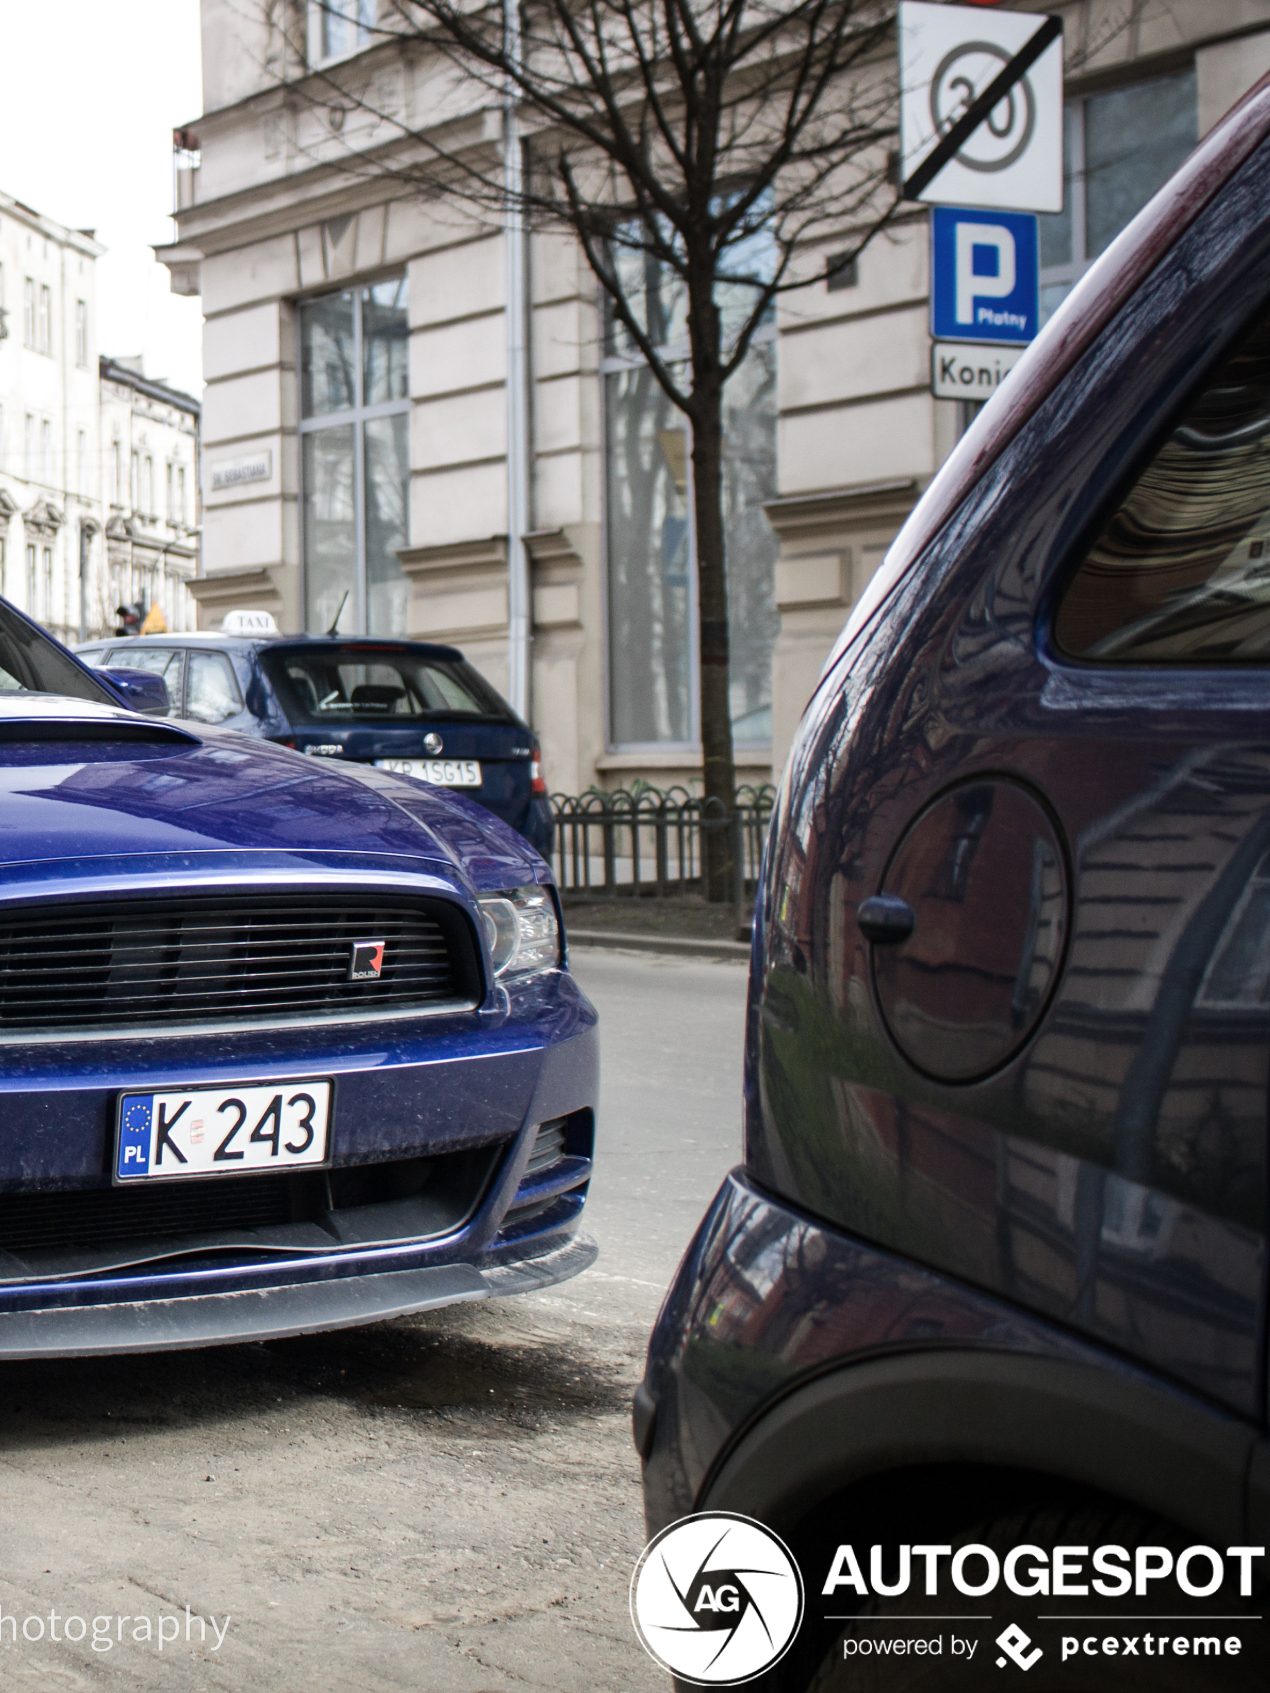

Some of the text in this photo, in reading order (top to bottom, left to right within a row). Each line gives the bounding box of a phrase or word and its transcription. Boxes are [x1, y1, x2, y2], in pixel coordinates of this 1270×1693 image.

[956, 223, 1016, 324] P
[977, 307, 1027, 330] Płatny
[941, 357, 1012, 386] Koni
[224, 462, 266, 483] SEBASTIANA
[238, 615, 270, 628] TAXI
[422, 761, 476, 783] 1SG15
[154, 1092, 317, 1166] K 243
[124, 1145, 147, 1163] PL
